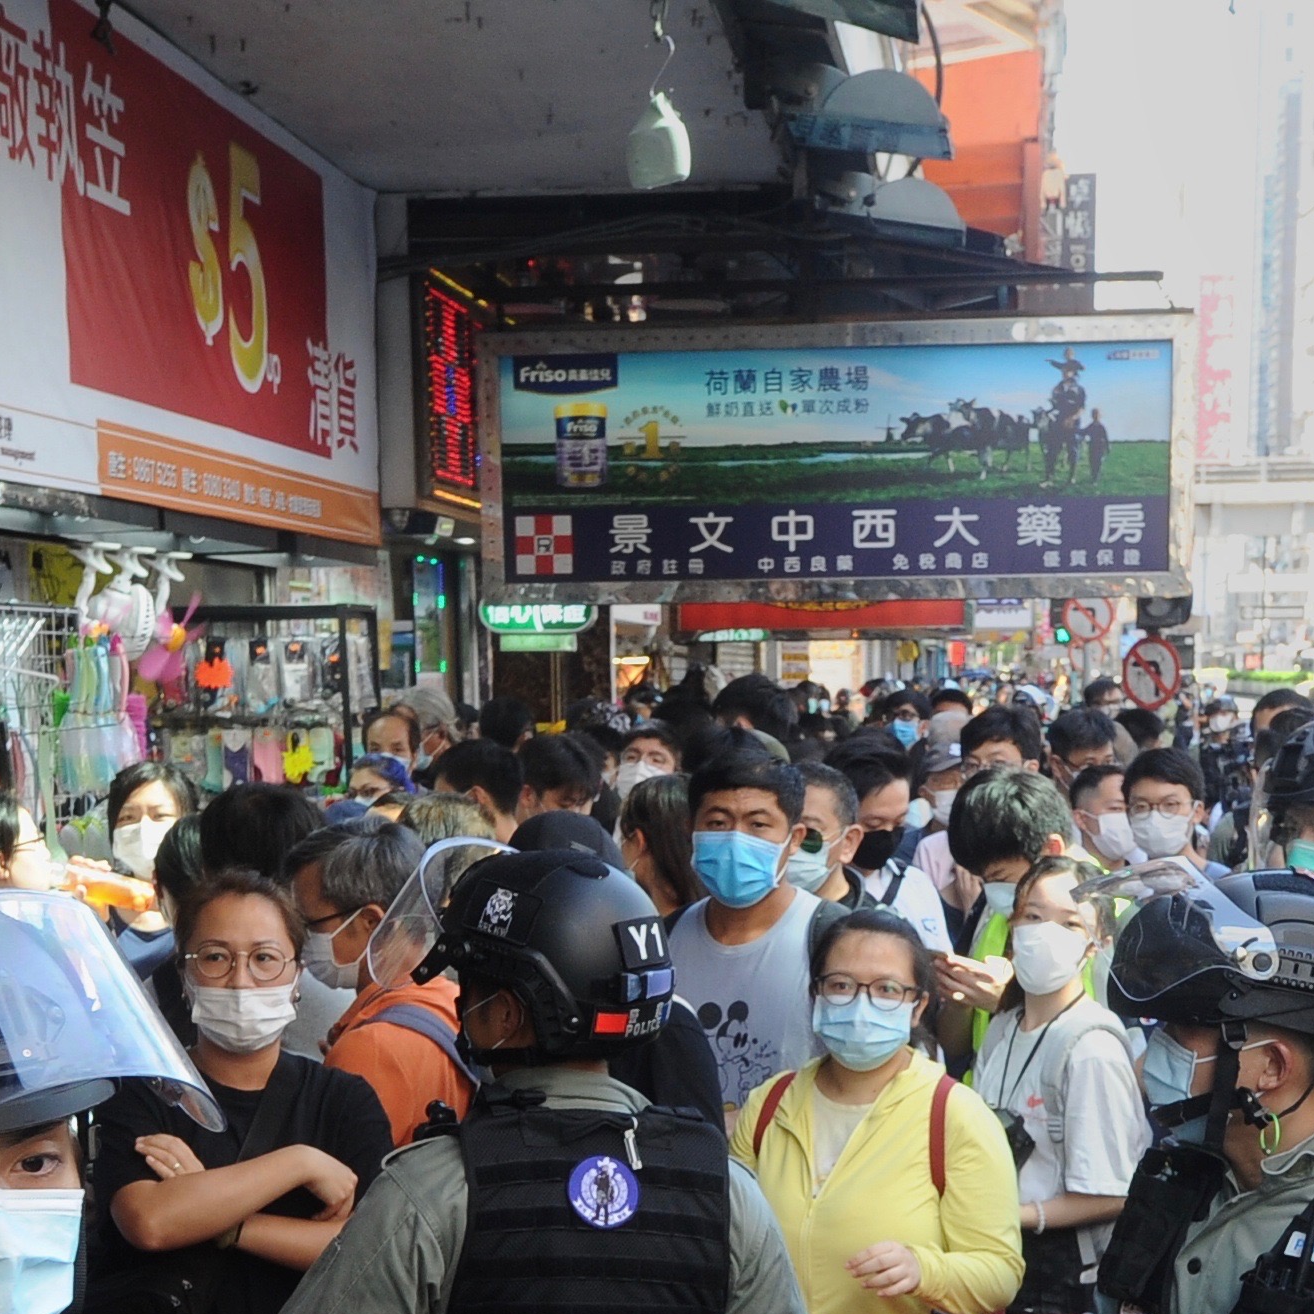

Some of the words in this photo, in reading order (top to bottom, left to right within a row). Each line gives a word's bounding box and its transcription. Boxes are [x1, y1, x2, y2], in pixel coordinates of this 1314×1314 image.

[520, 361, 567, 383] Friso
[705, 365, 870, 397] 荷蘭自家農場
[306, 338, 359, 454] 清貨
[706, 400, 775, 418] 鮮奶直送
[801, 398, 870, 415] 單次成粉
[609, 503, 1146, 553] 景文中西大藥房
[610, 558, 704, 575] 政府註冊
[757, 555, 854, 573] 中西良藥
[892, 552, 989, 571] 免稅商店
[628, 921, 664, 961] Y1
